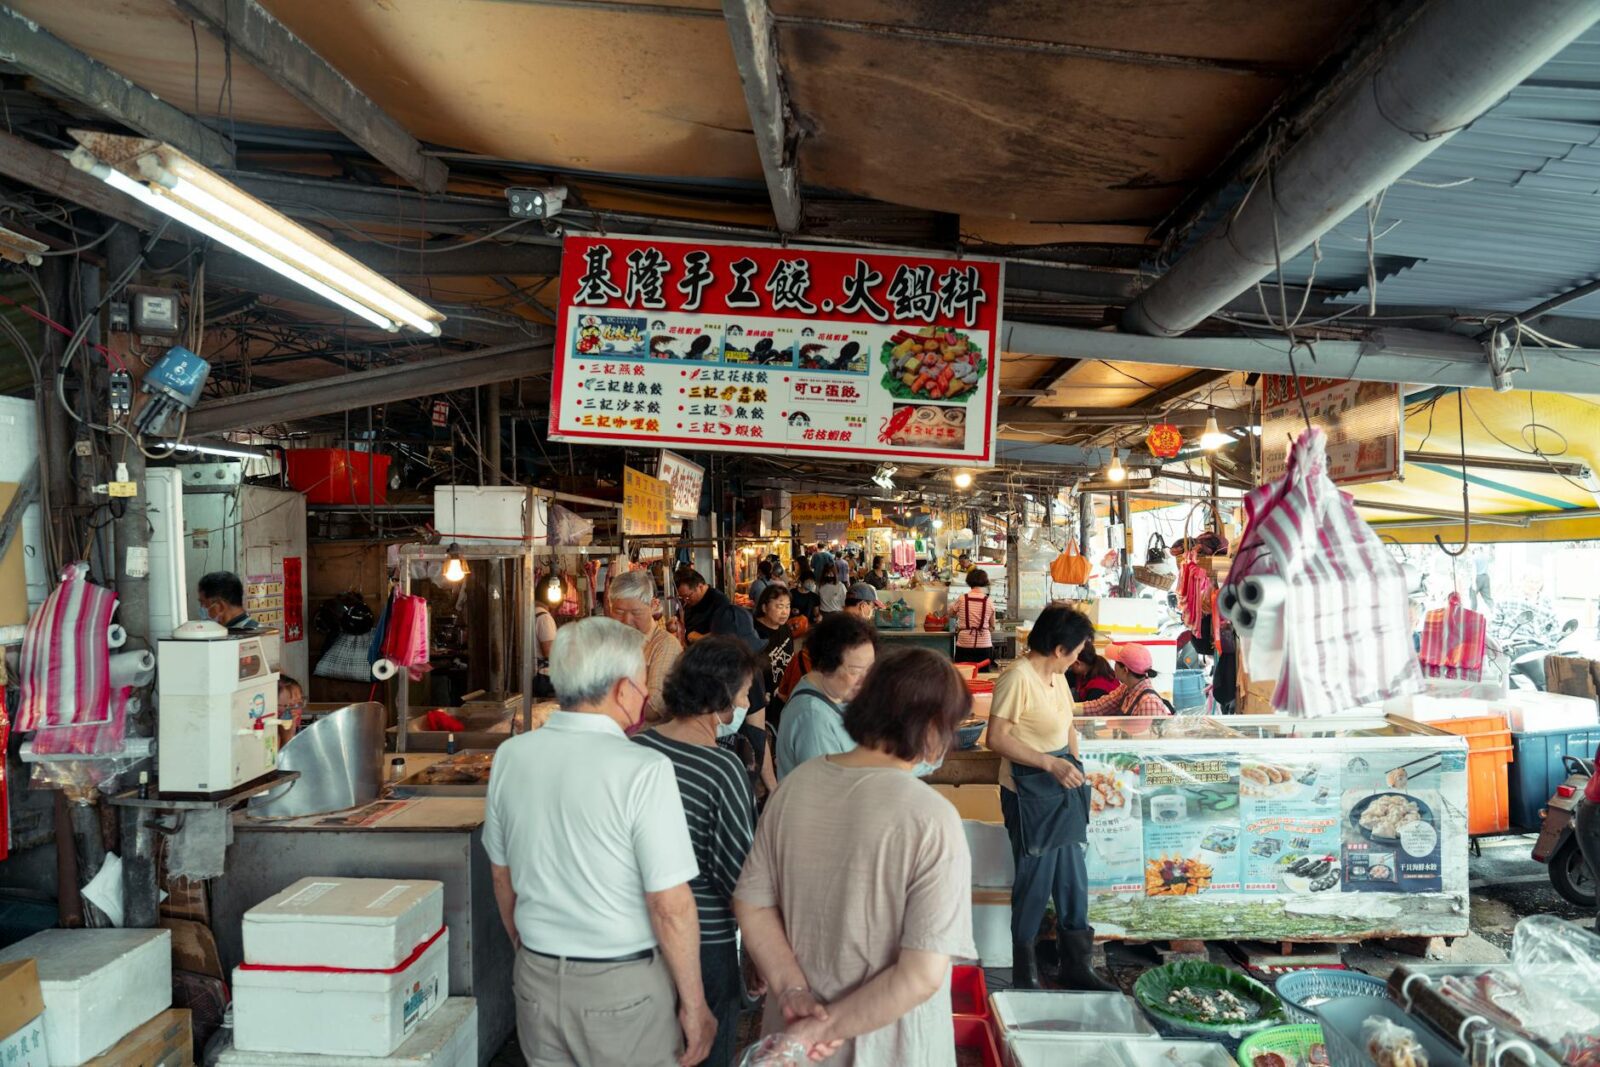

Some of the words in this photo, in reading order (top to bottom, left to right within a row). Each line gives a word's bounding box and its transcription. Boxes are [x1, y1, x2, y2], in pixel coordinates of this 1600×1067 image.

[589, 363, 646, 377] 三記燕餃
[700, 368, 768, 384] 三記花枝餃
[594, 379, 663, 396] 三記鮭魚餃
[583, 398, 661, 414] 三記沙茶餃
[581, 414, 660, 432] 三記咖哩餃
